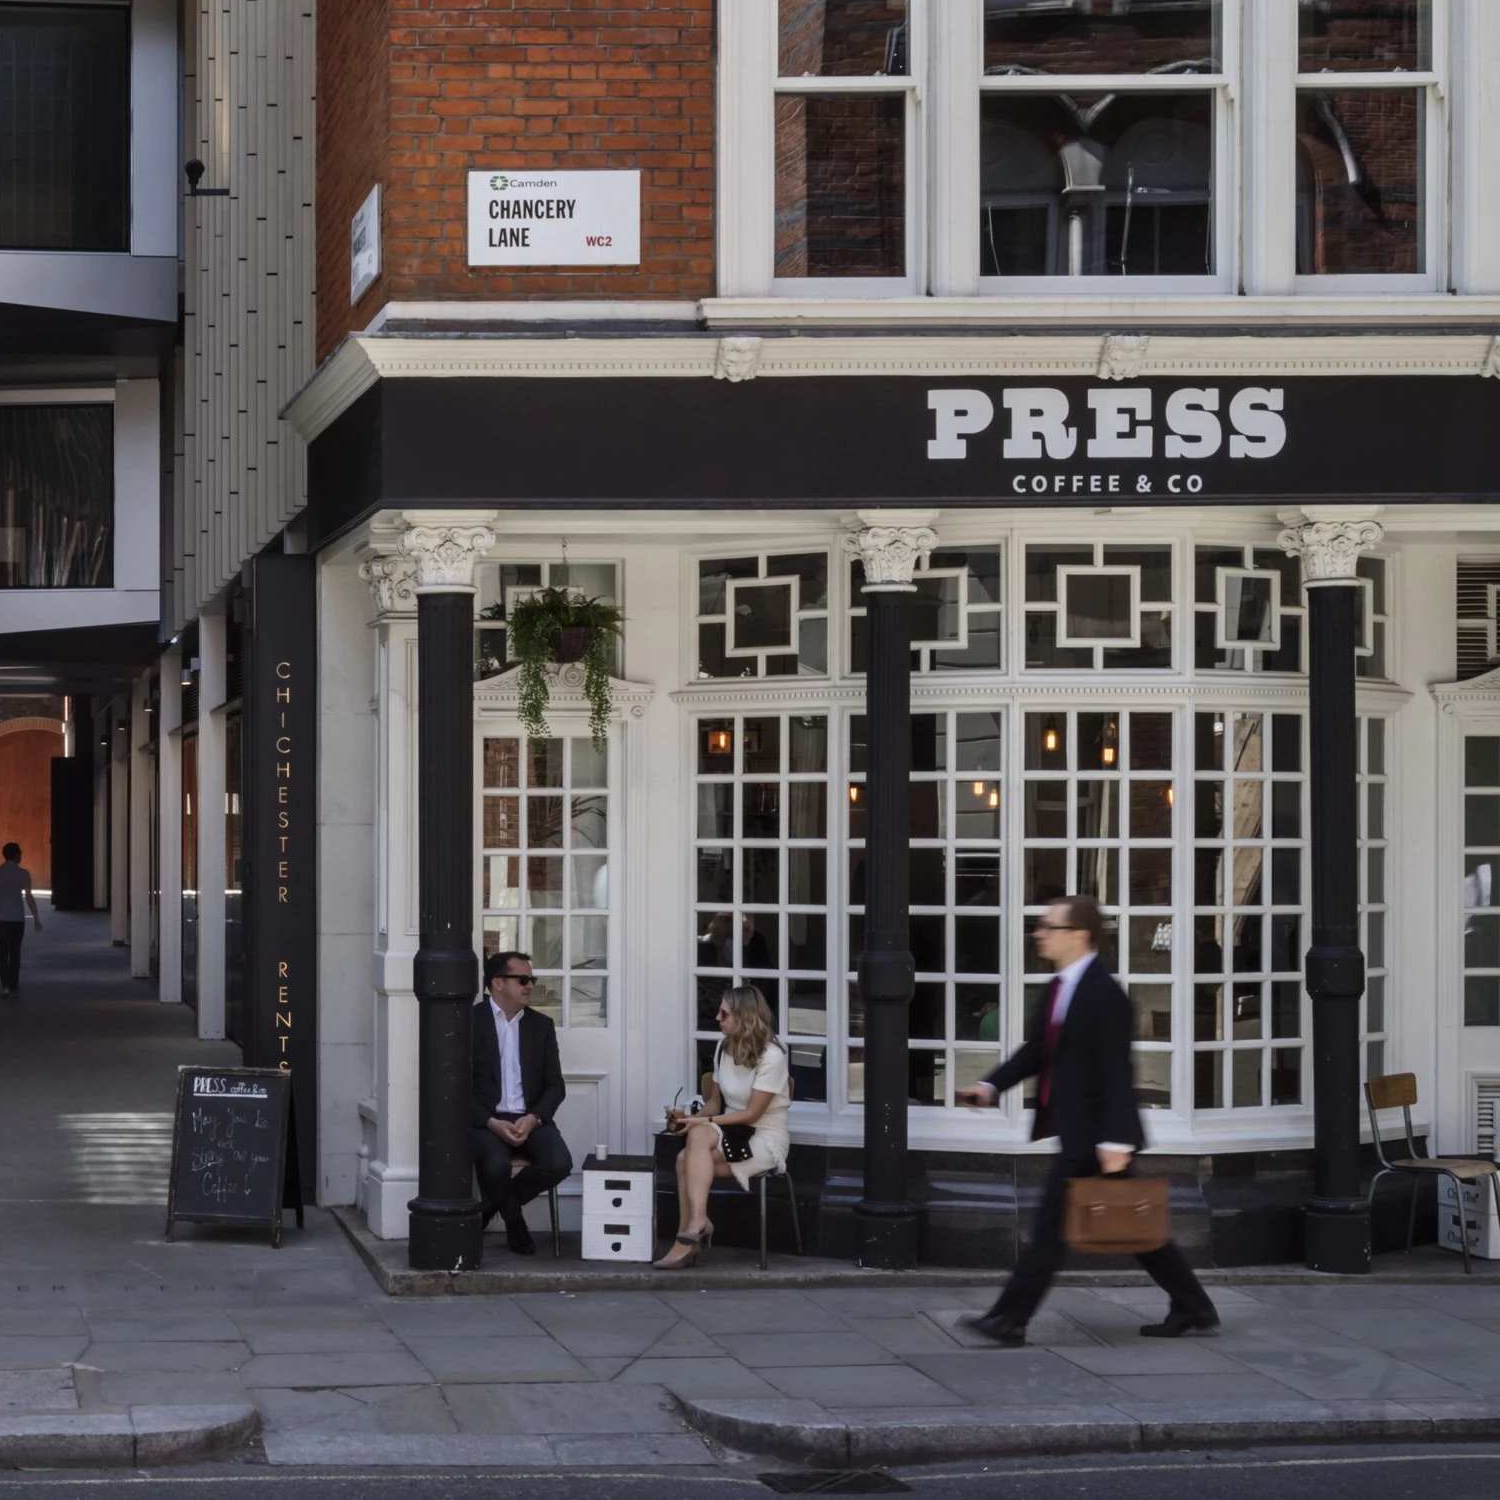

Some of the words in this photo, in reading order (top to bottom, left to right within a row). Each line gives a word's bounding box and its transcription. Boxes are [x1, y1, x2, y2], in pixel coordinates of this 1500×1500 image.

[509, 178, 557, 188] Camden
[488, 199, 576, 220] CHANCERY
[488, 227, 530, 248] LANE
[585, 235, 612, 247] WC2
[926, 387, 1287, 459] PRESS
[1012, 474, 1120, 494] COFFEE
[1135, 474, 1153, 494] &
[1167, 474, 1204, 494] CO
[275, 661, 291, 904] CHICHESTER
[193, 1076, 227, 1094] PRESS
